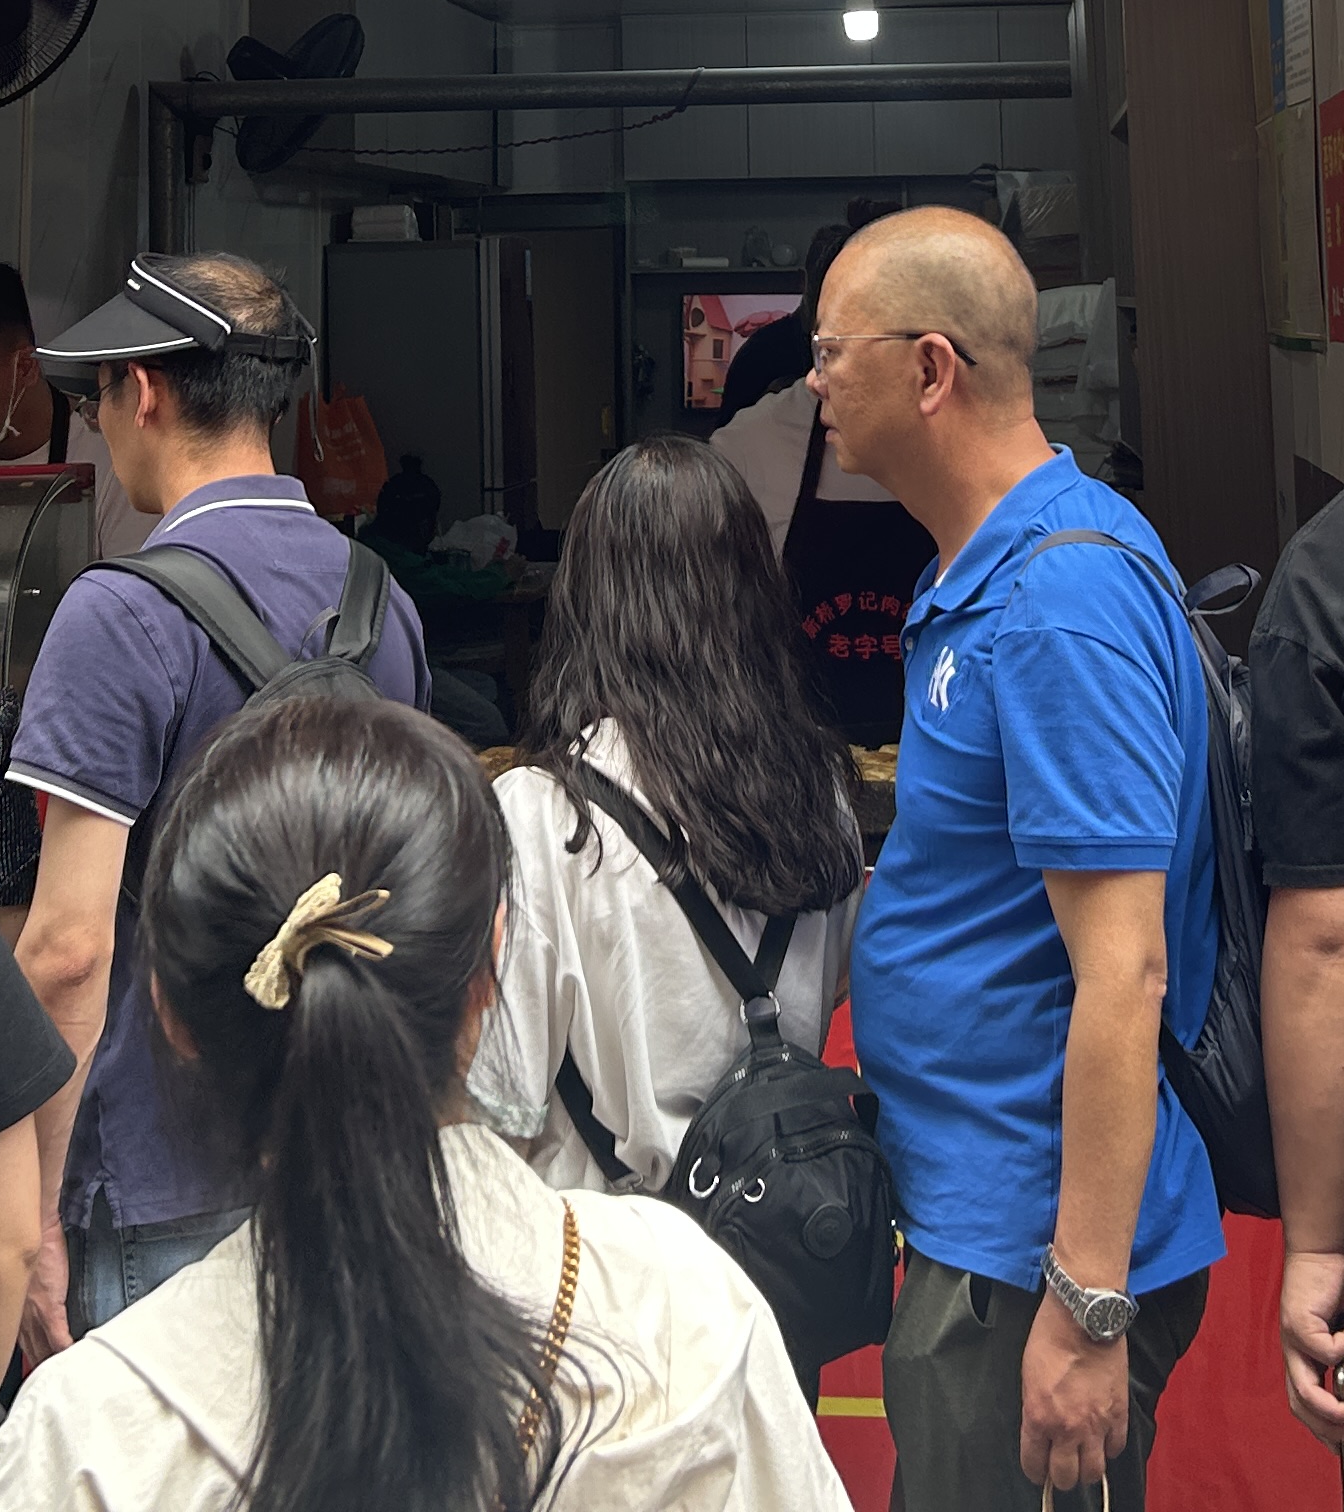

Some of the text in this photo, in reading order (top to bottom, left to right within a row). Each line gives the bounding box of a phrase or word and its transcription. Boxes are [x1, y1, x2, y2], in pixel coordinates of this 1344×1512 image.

[801, 590, 914, 640] 新桥罗记肉
